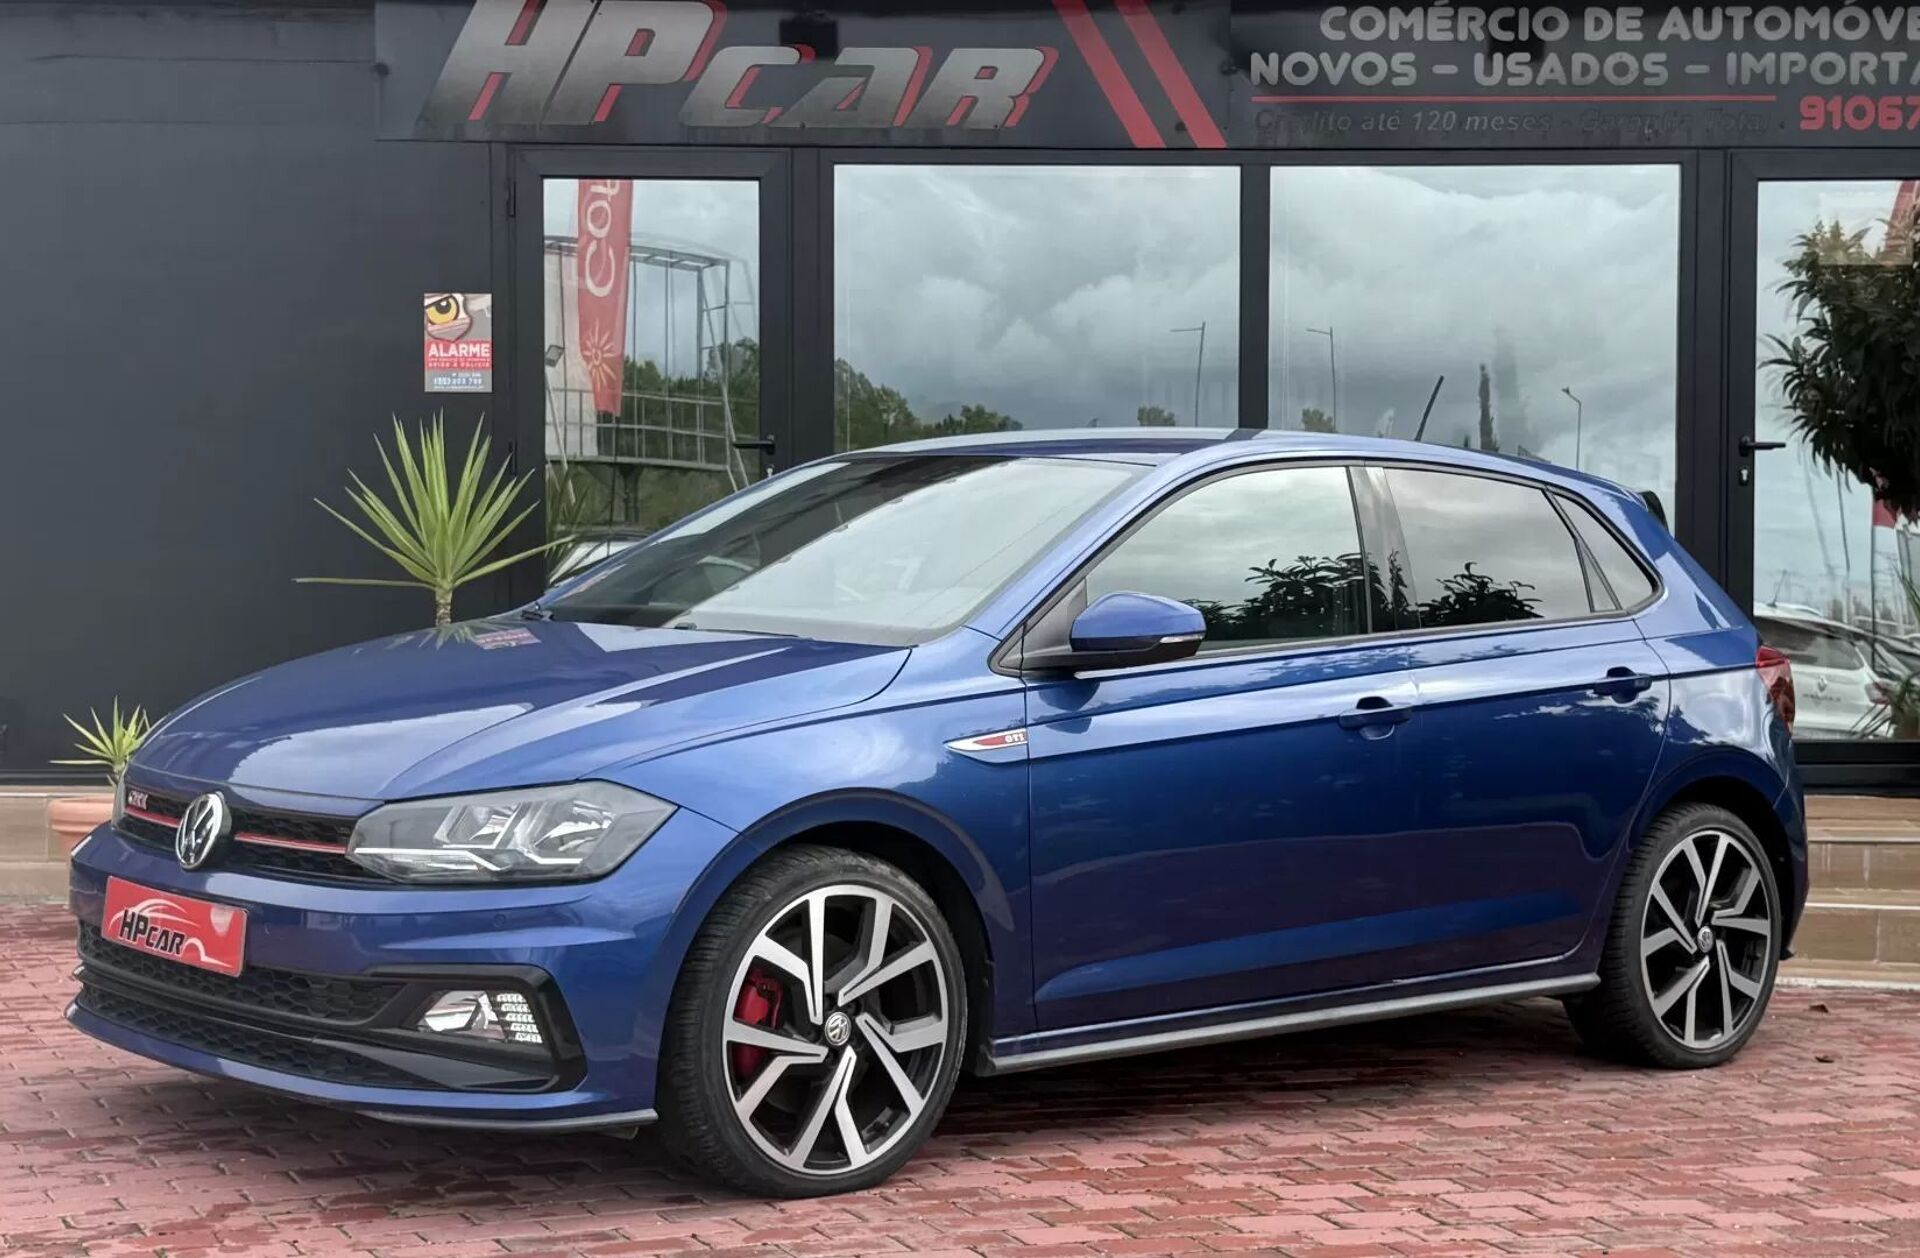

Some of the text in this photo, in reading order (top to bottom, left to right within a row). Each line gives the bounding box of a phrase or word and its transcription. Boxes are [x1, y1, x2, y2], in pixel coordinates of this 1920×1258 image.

[1319, 0, 1570, 42] COMÉRCIO
[1583, 6, 1645, 42] DE
[1250, 51, 1418, 87] NOVOS
[1473, 51, 1669, 87] USADOS
[1725, 51, 1920, 87] IMPORT
[1360, 108, 1402, 132] até
[1411, 110, 1457, 132] 120
[1464, 114, 1553, 132] meses
[428, 343, 491, 357] ALARME
